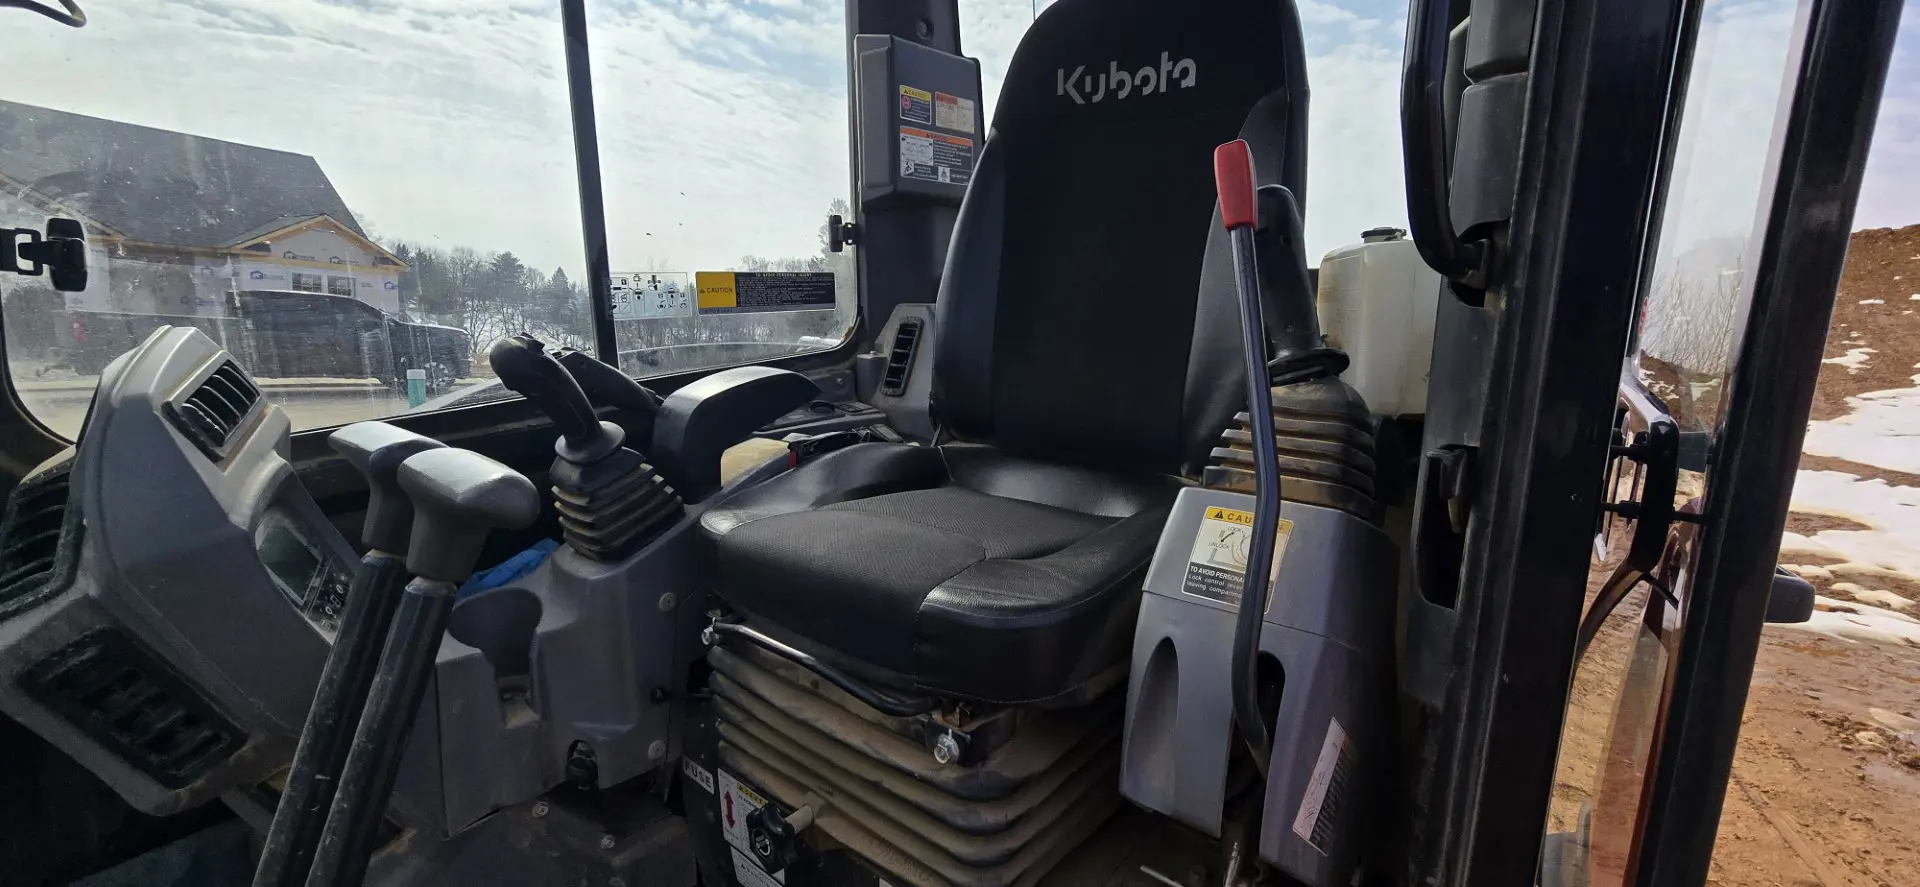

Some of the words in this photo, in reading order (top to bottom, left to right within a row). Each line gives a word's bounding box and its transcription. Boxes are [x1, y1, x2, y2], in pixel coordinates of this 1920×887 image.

[1057, 51, 1196, 104] Kubota
[1209, 541, 1230, 549] UNLOCK
[1190, 565, 1198, 573] TO
[1198, 567, 1215, 577] AVOID
[1215, 571, 1245, 583] PERSONA
[1186, 580, 1207, 590] leaving
[1204, 577, 1225, 586] control
[685, 760, 711, 788] FUSE
